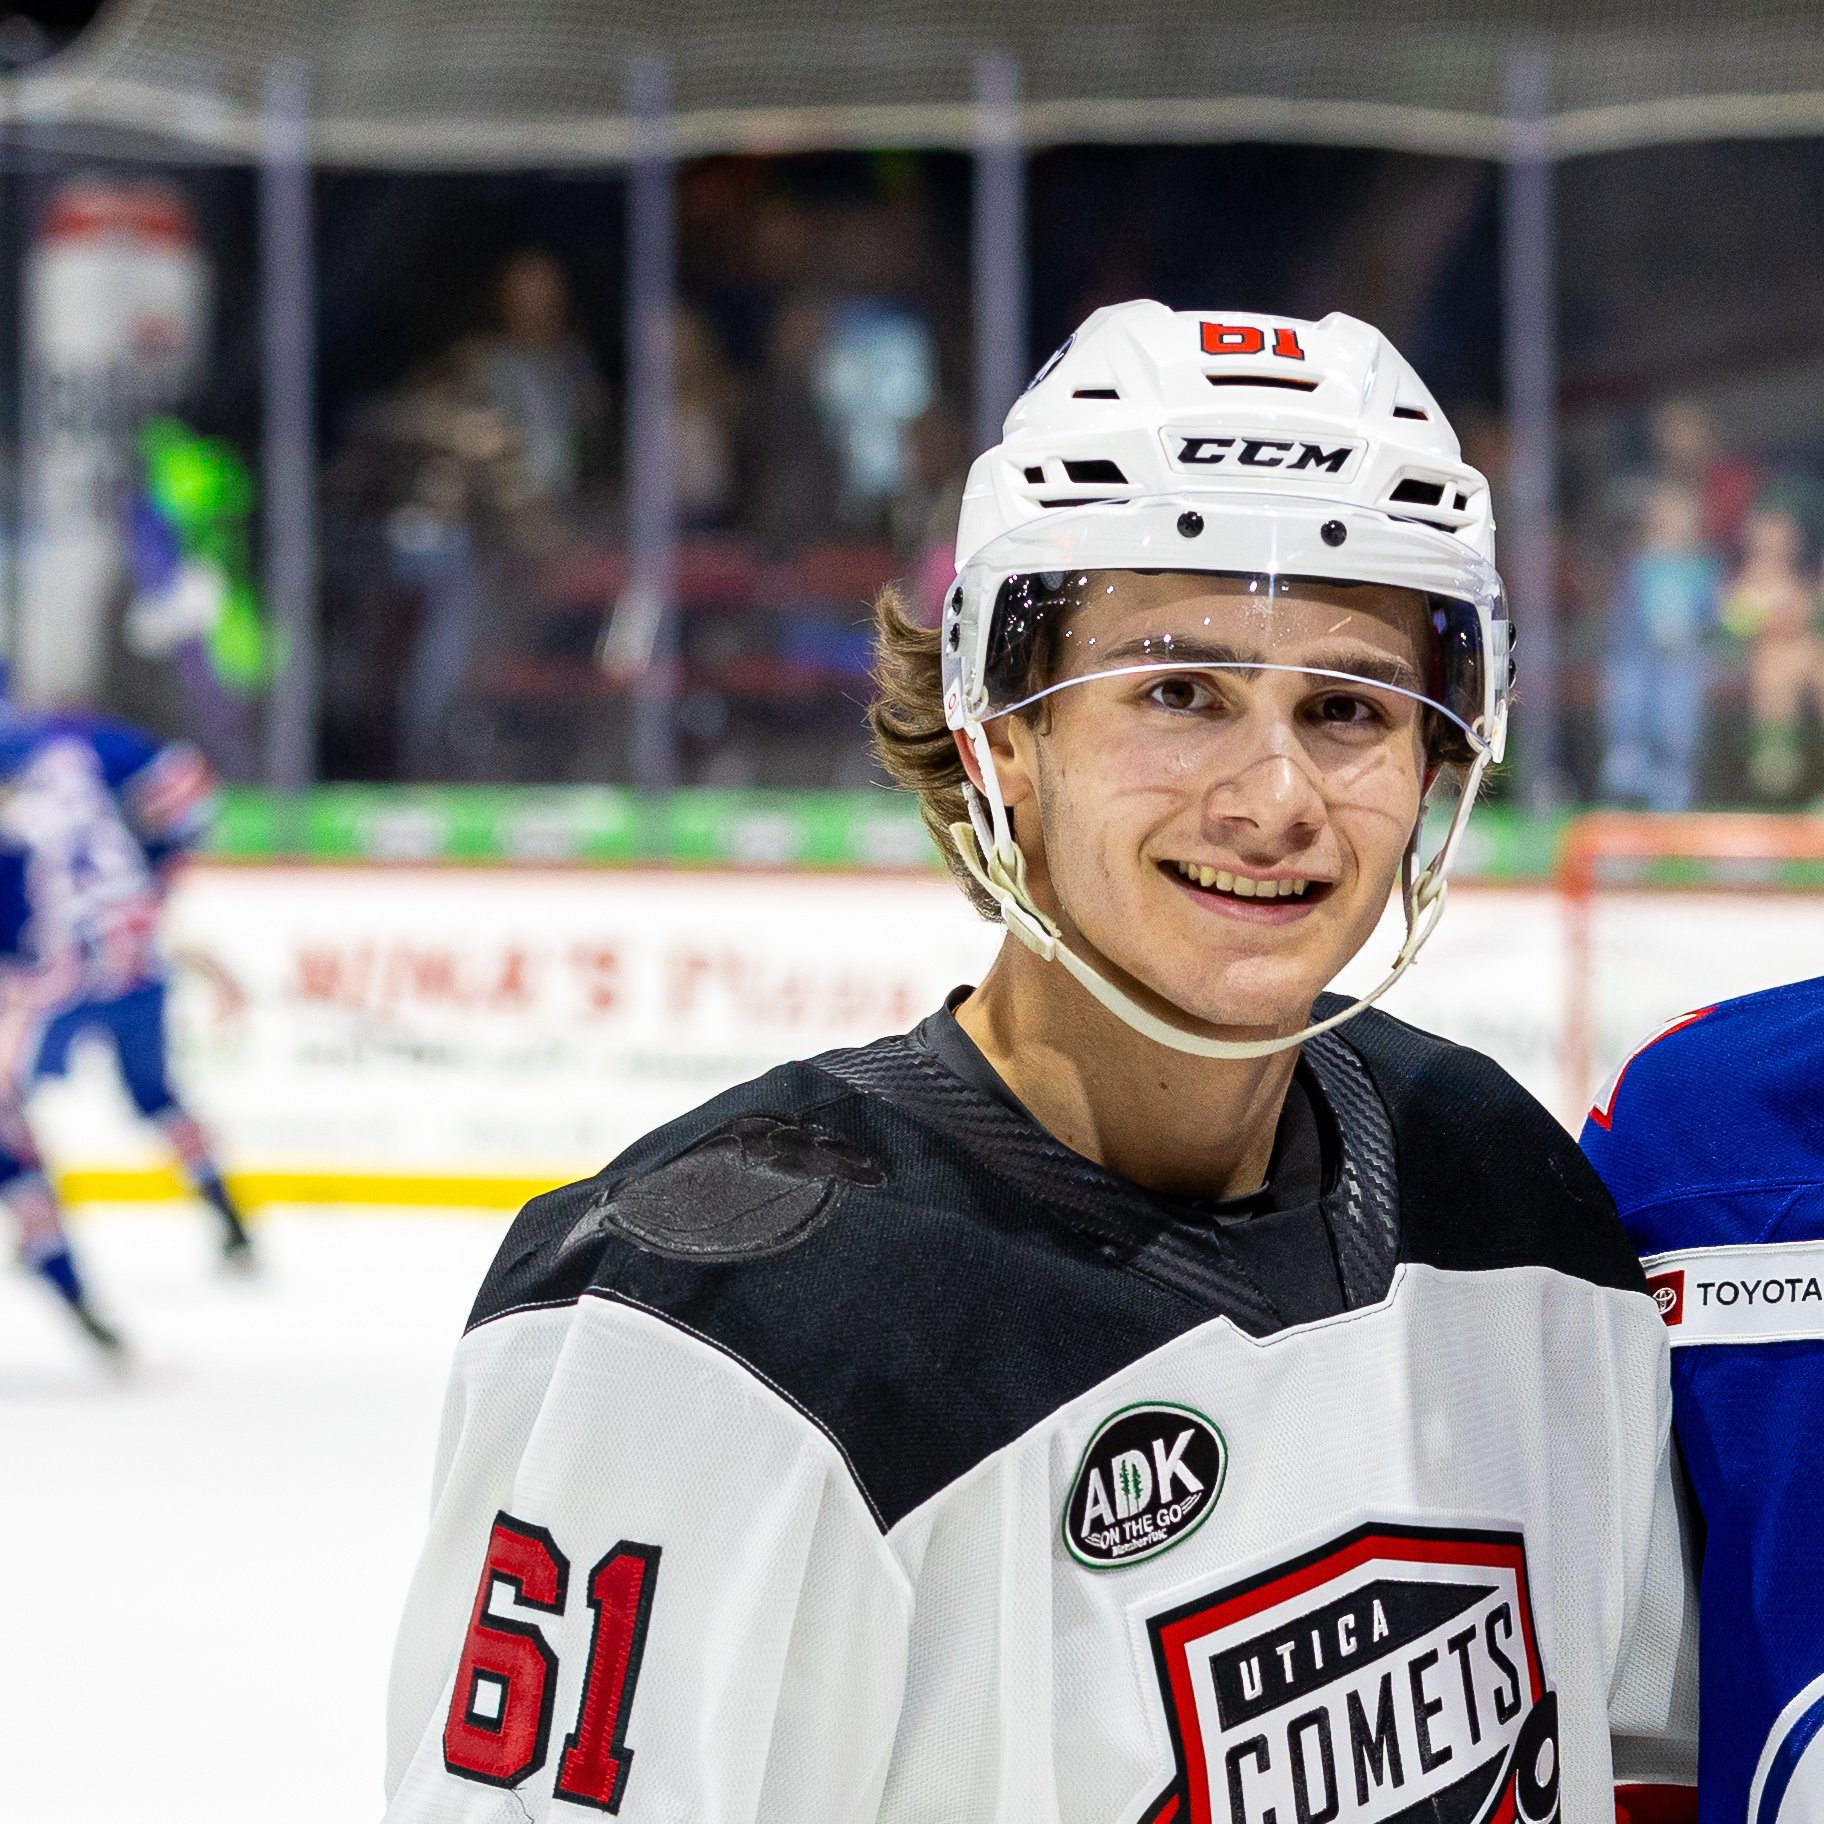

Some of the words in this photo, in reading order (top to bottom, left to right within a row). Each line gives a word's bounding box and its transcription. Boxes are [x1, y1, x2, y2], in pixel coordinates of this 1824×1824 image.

[1176, 436, 1353, 474] CCM
[1696, 1277, 1823, 1307] TOYOTA
[1081, 1428, 1205, 1539] ADK
[1100, 1526, 1121, 1550] ON
[1123, 1514, 1155, 1540] THE
[1156, 1504, 1183, 1528] GO
[442, 1508, 664, 1816] 61
[1238, 1599, 1390, 1701] UTICA
